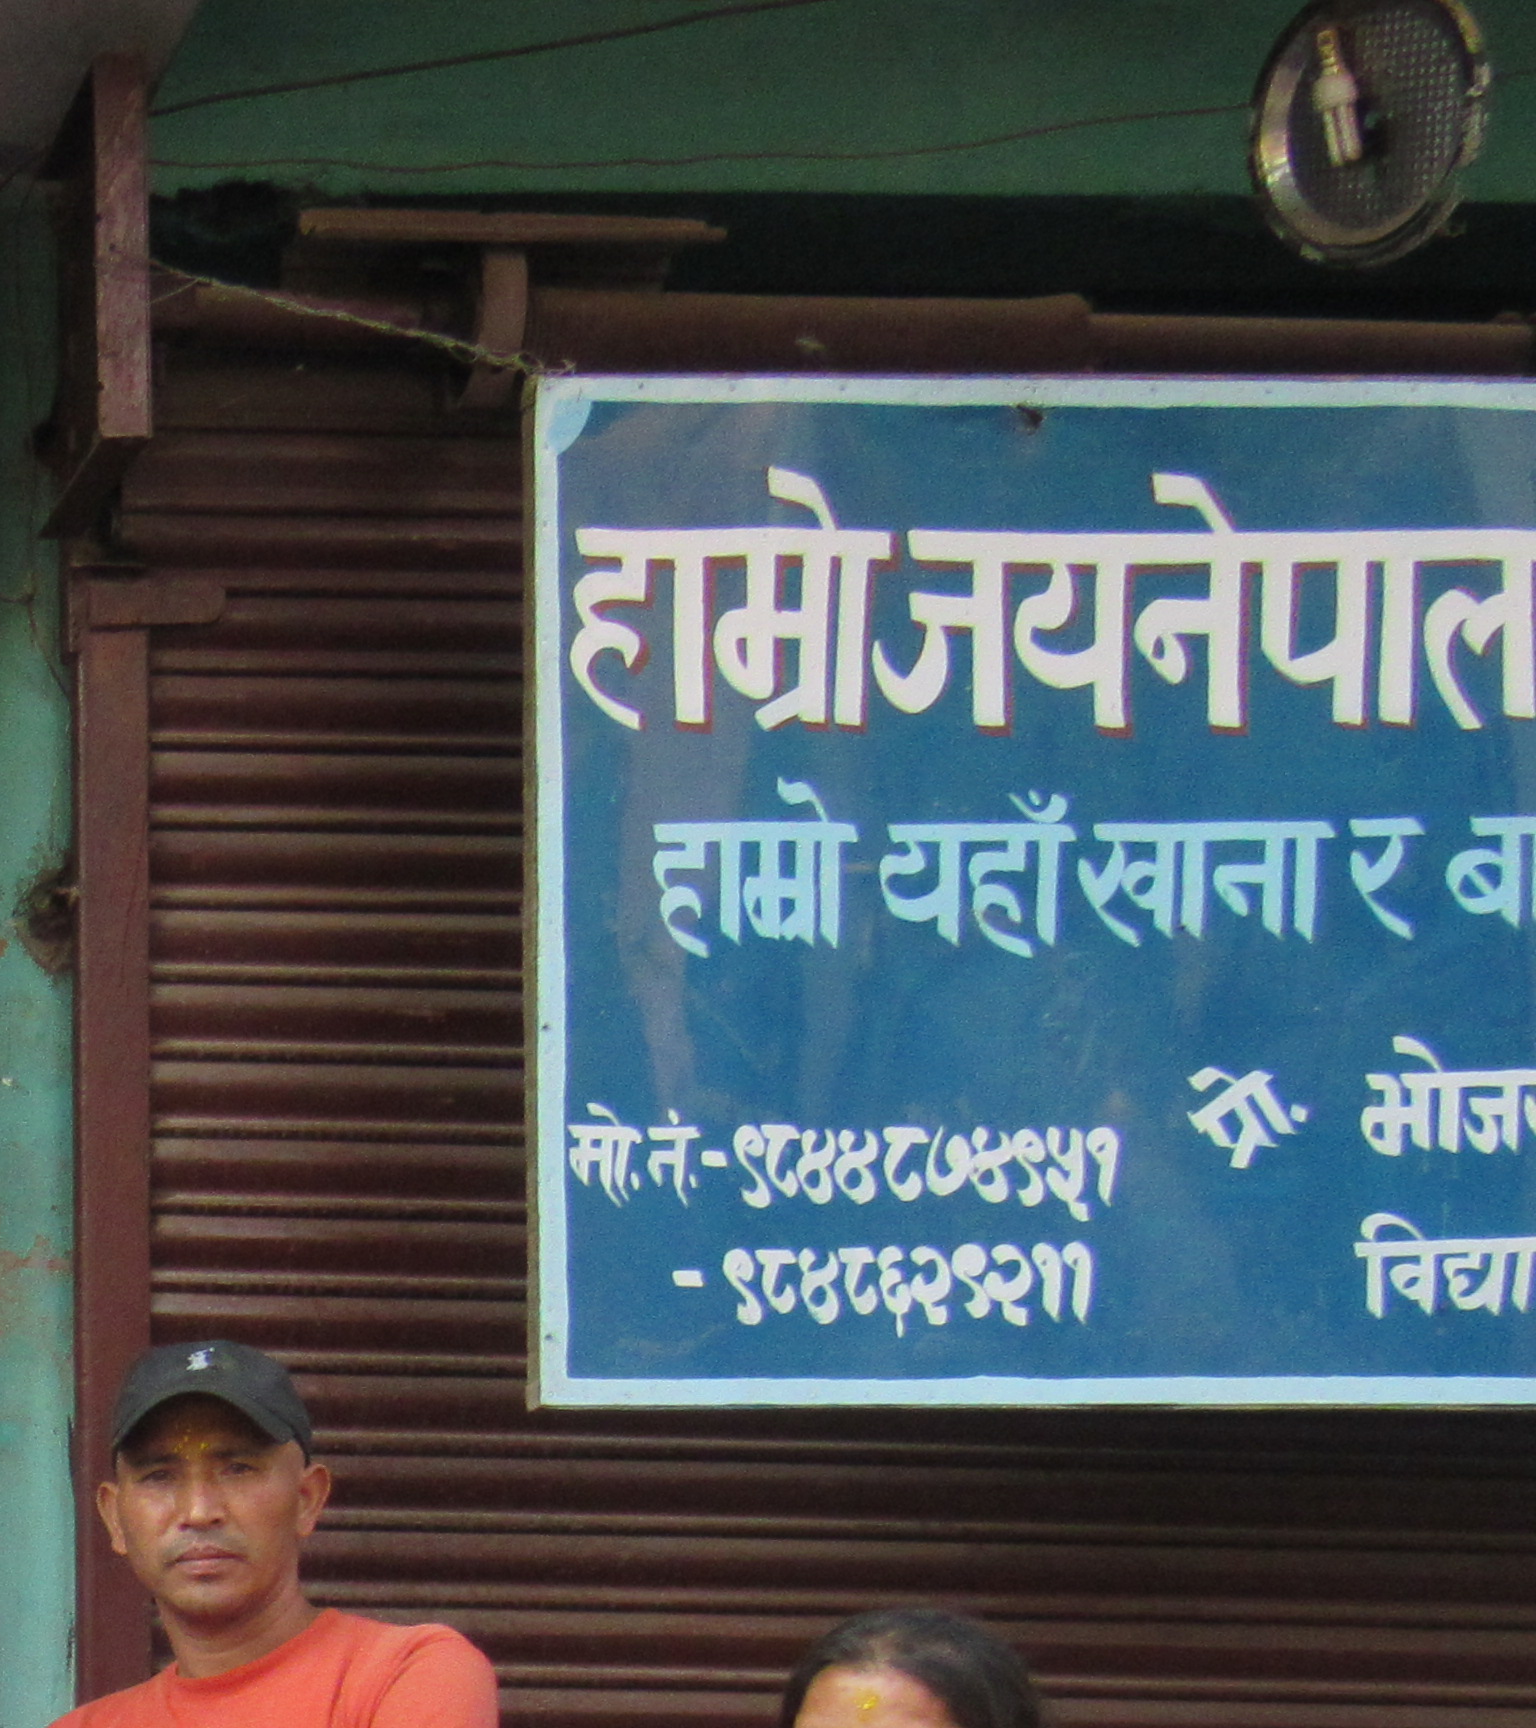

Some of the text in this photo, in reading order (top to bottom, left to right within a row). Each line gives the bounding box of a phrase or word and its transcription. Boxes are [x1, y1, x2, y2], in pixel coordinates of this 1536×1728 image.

[879, 790, 1077, 958] यहाँ
[1078, 820, 1336, 948] खाना
[1349, 817, 1426, 940] र
[1360, 1034, 1536, 1157] भोज
